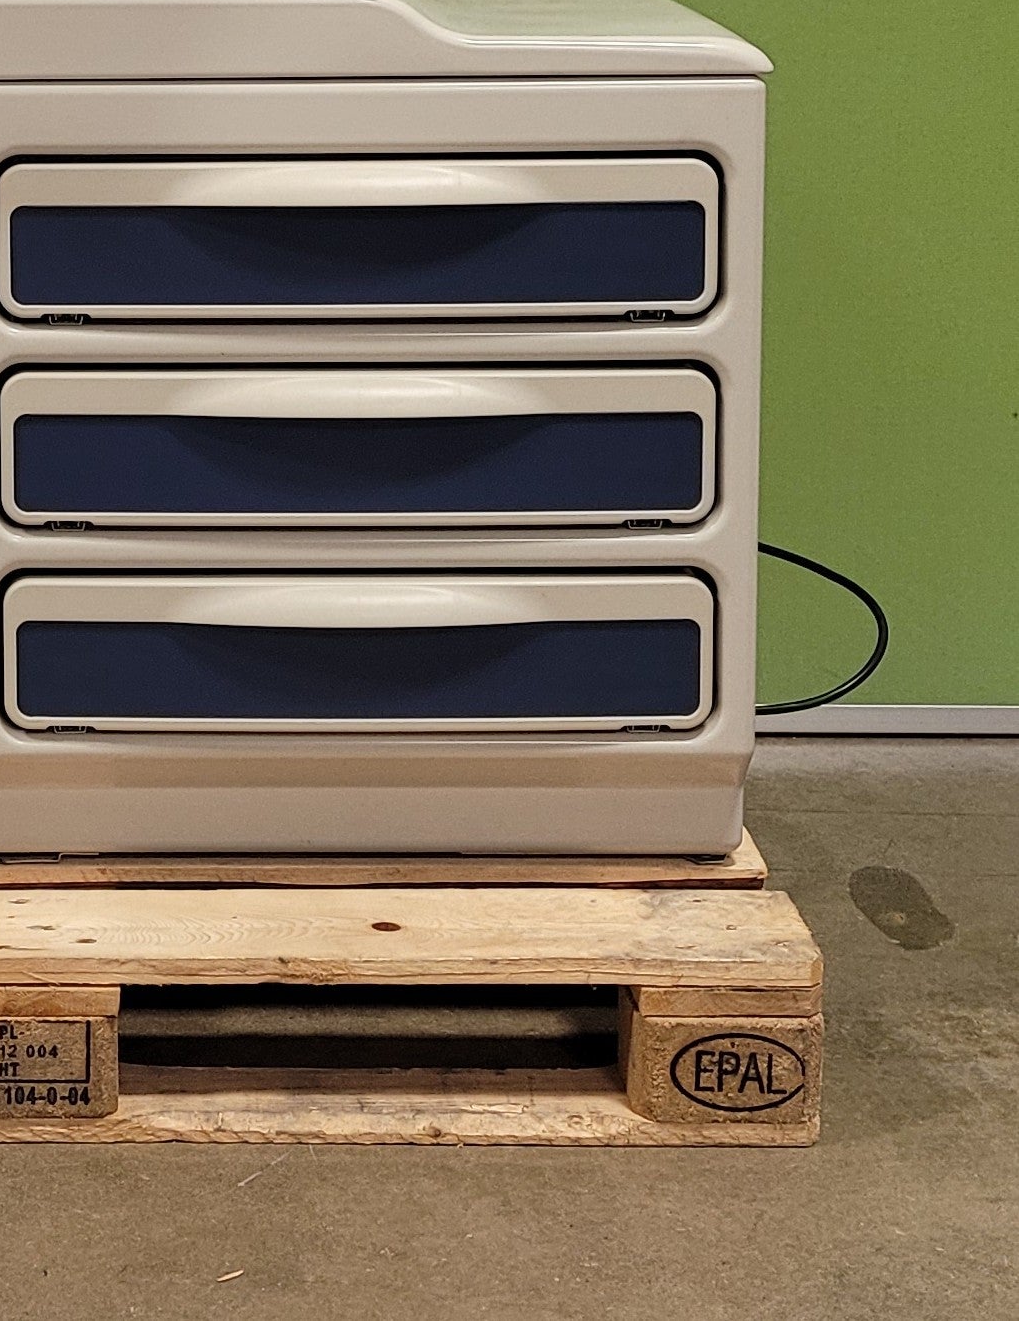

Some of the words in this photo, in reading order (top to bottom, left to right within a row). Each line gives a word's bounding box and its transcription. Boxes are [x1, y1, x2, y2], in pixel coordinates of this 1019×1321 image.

[0, 1044, 17, 1059] 12
[26, 1044, 59, 1059] 004
[694, 1049, 788, 1095] EPAL
[4, 1086, 91, 1106] 104-0-04
